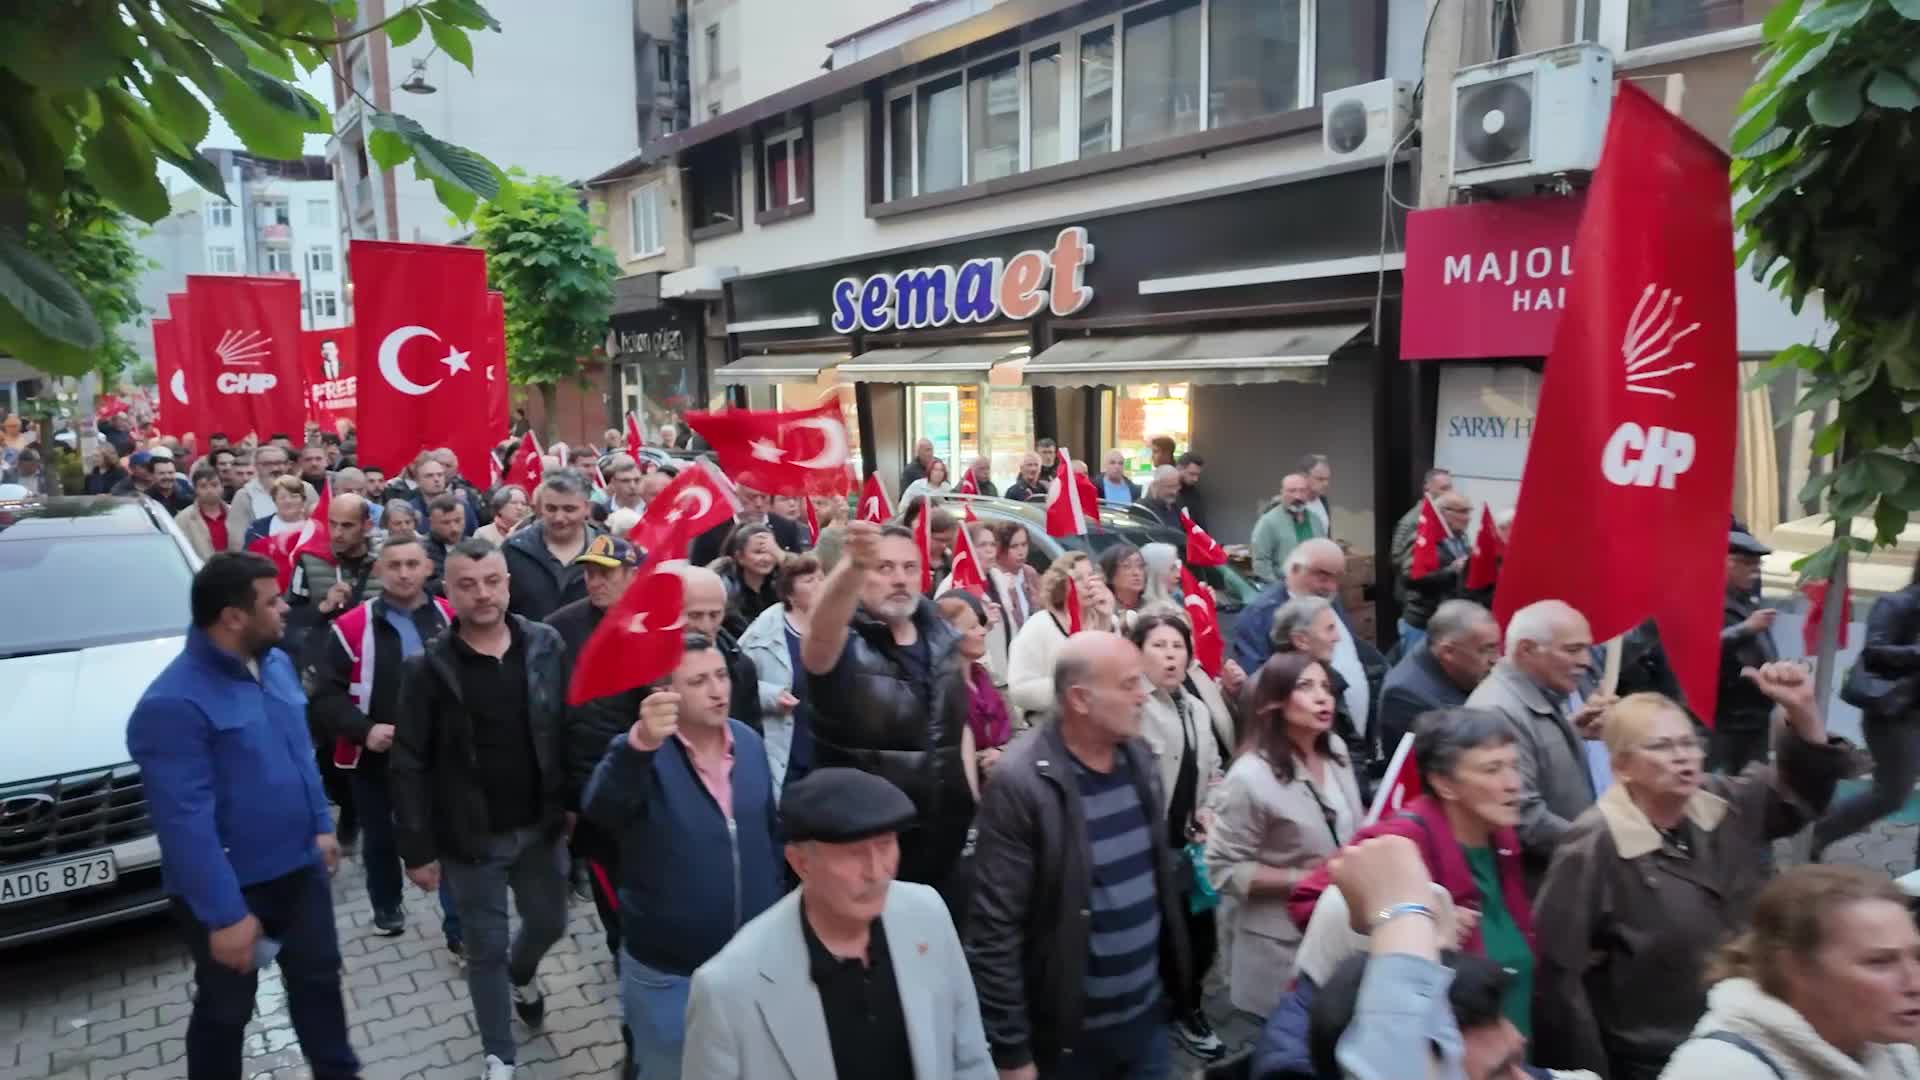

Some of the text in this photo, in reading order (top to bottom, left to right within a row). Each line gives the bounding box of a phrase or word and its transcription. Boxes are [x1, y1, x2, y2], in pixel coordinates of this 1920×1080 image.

[832, 227, 1095, 334] semaet
[216, 372, 277, 394] CHP
[1448, 415, 1509, 438] SARAY
[1601, 421, 1696, 490] CHP
[2, 860, 110, 900] ADG 873
